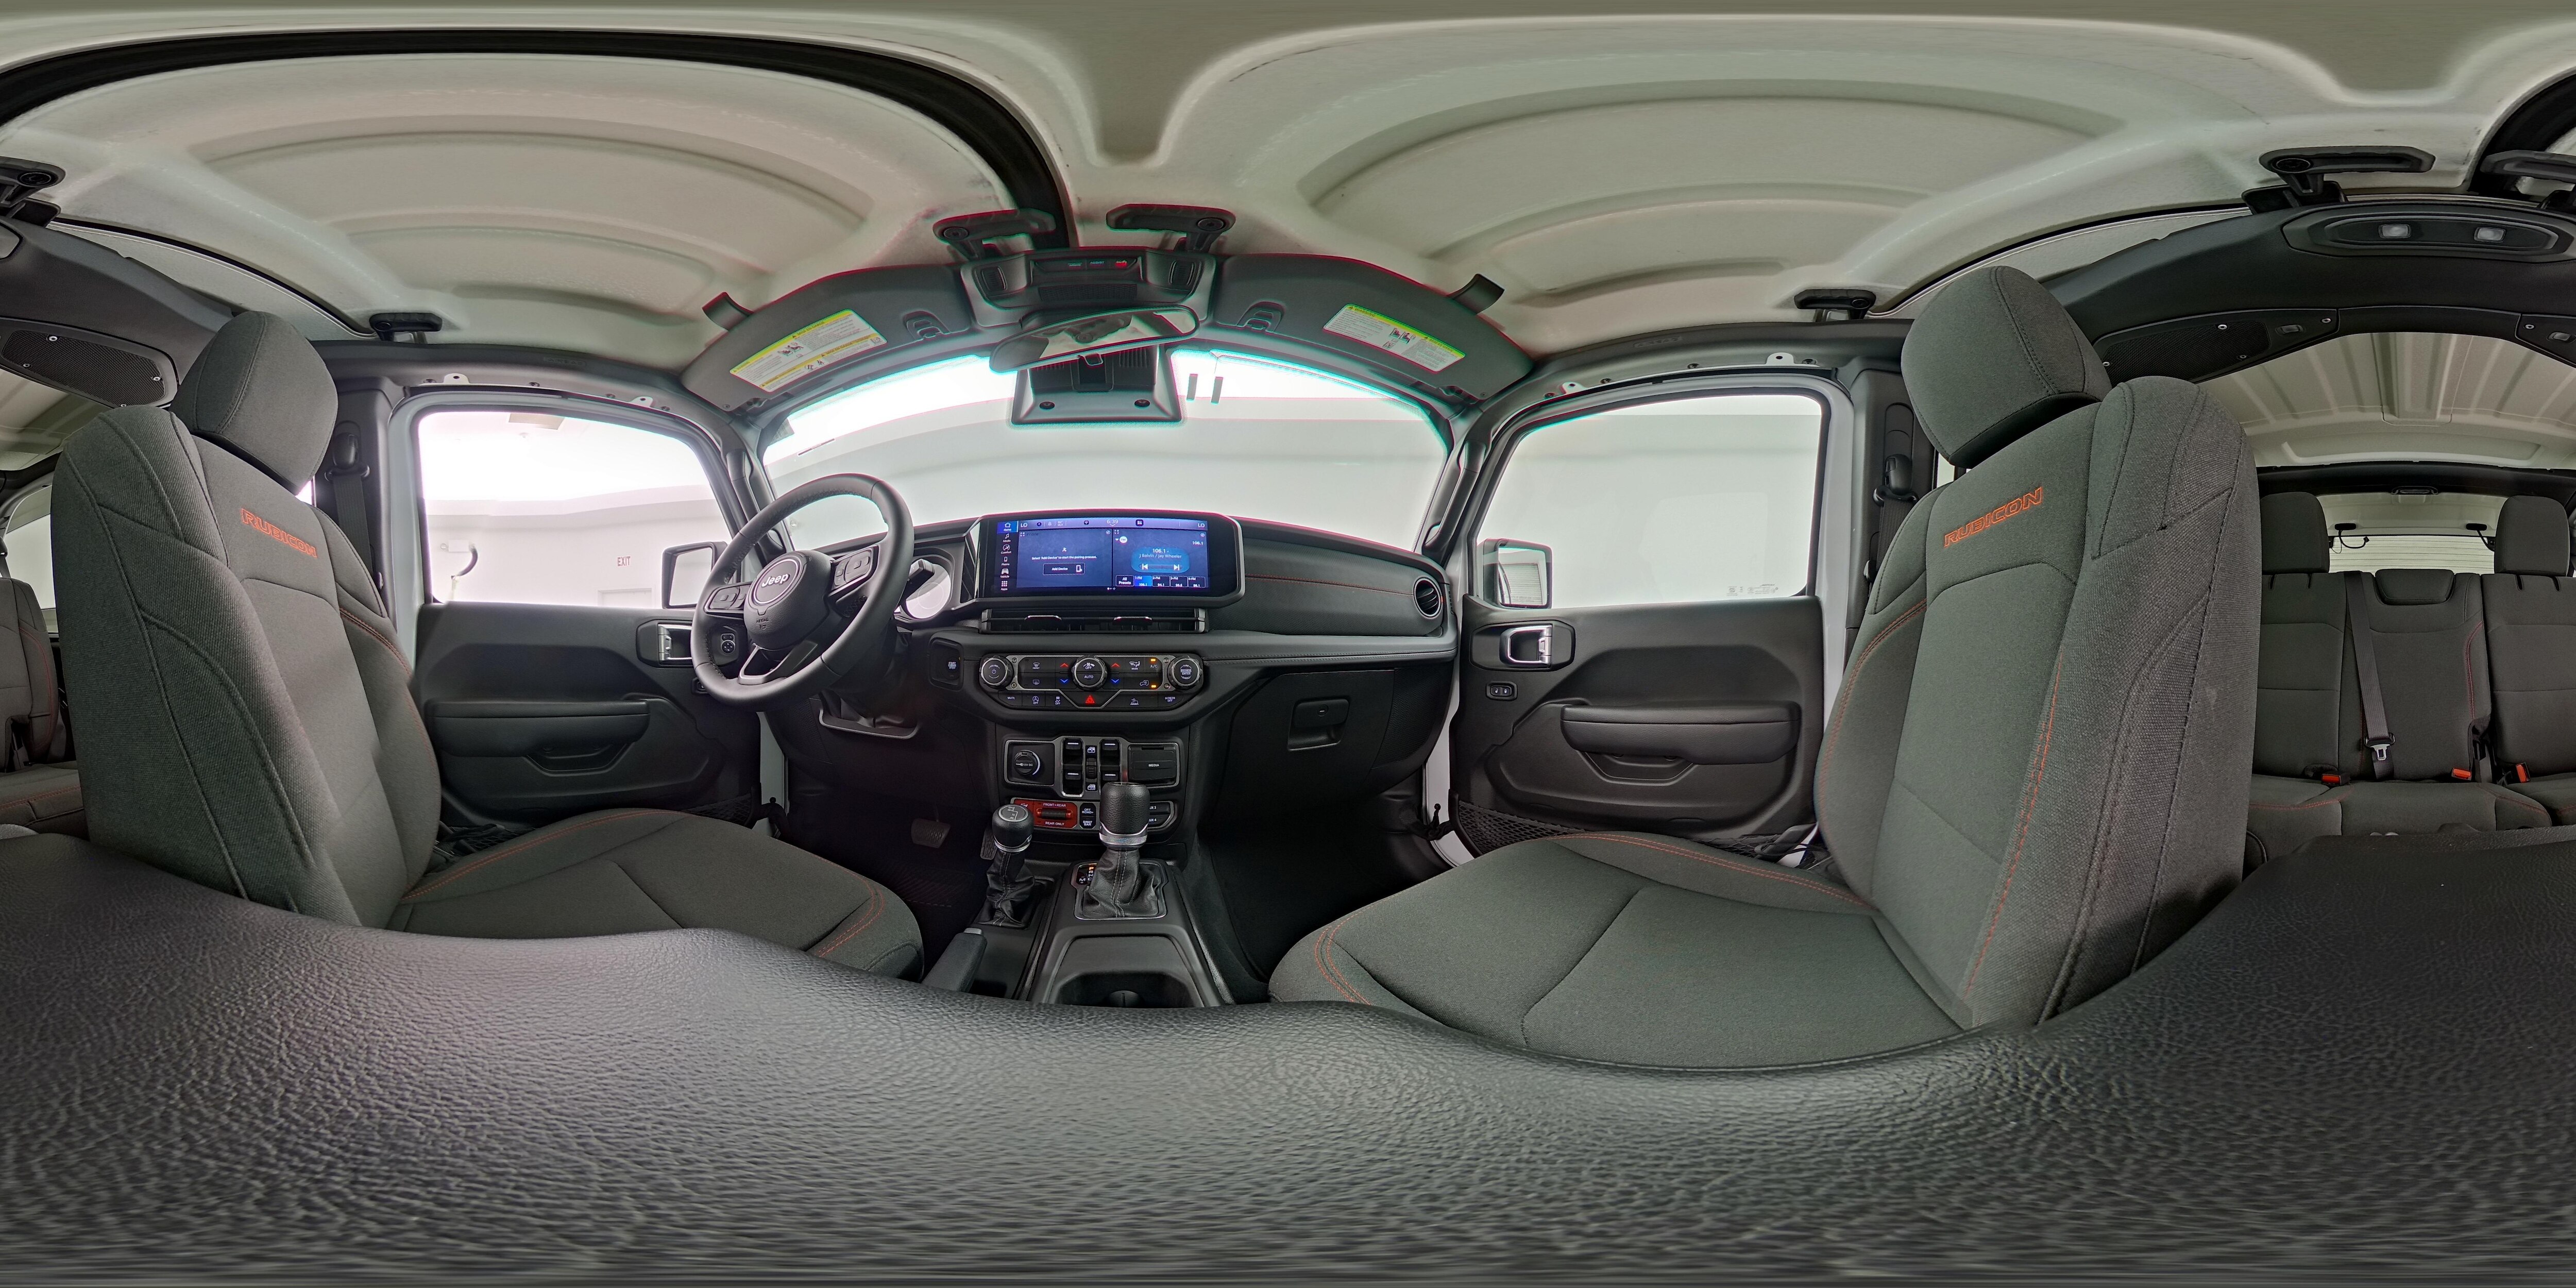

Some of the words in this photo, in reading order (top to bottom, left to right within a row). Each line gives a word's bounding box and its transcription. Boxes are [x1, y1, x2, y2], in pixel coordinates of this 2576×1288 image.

[1944, 486, 2044, 547] RUBICON
[241, 508, 318, 558] RUBICON
[618, 556, 630, 566] EXIT
[762, 573, 789, 587] Jeep
